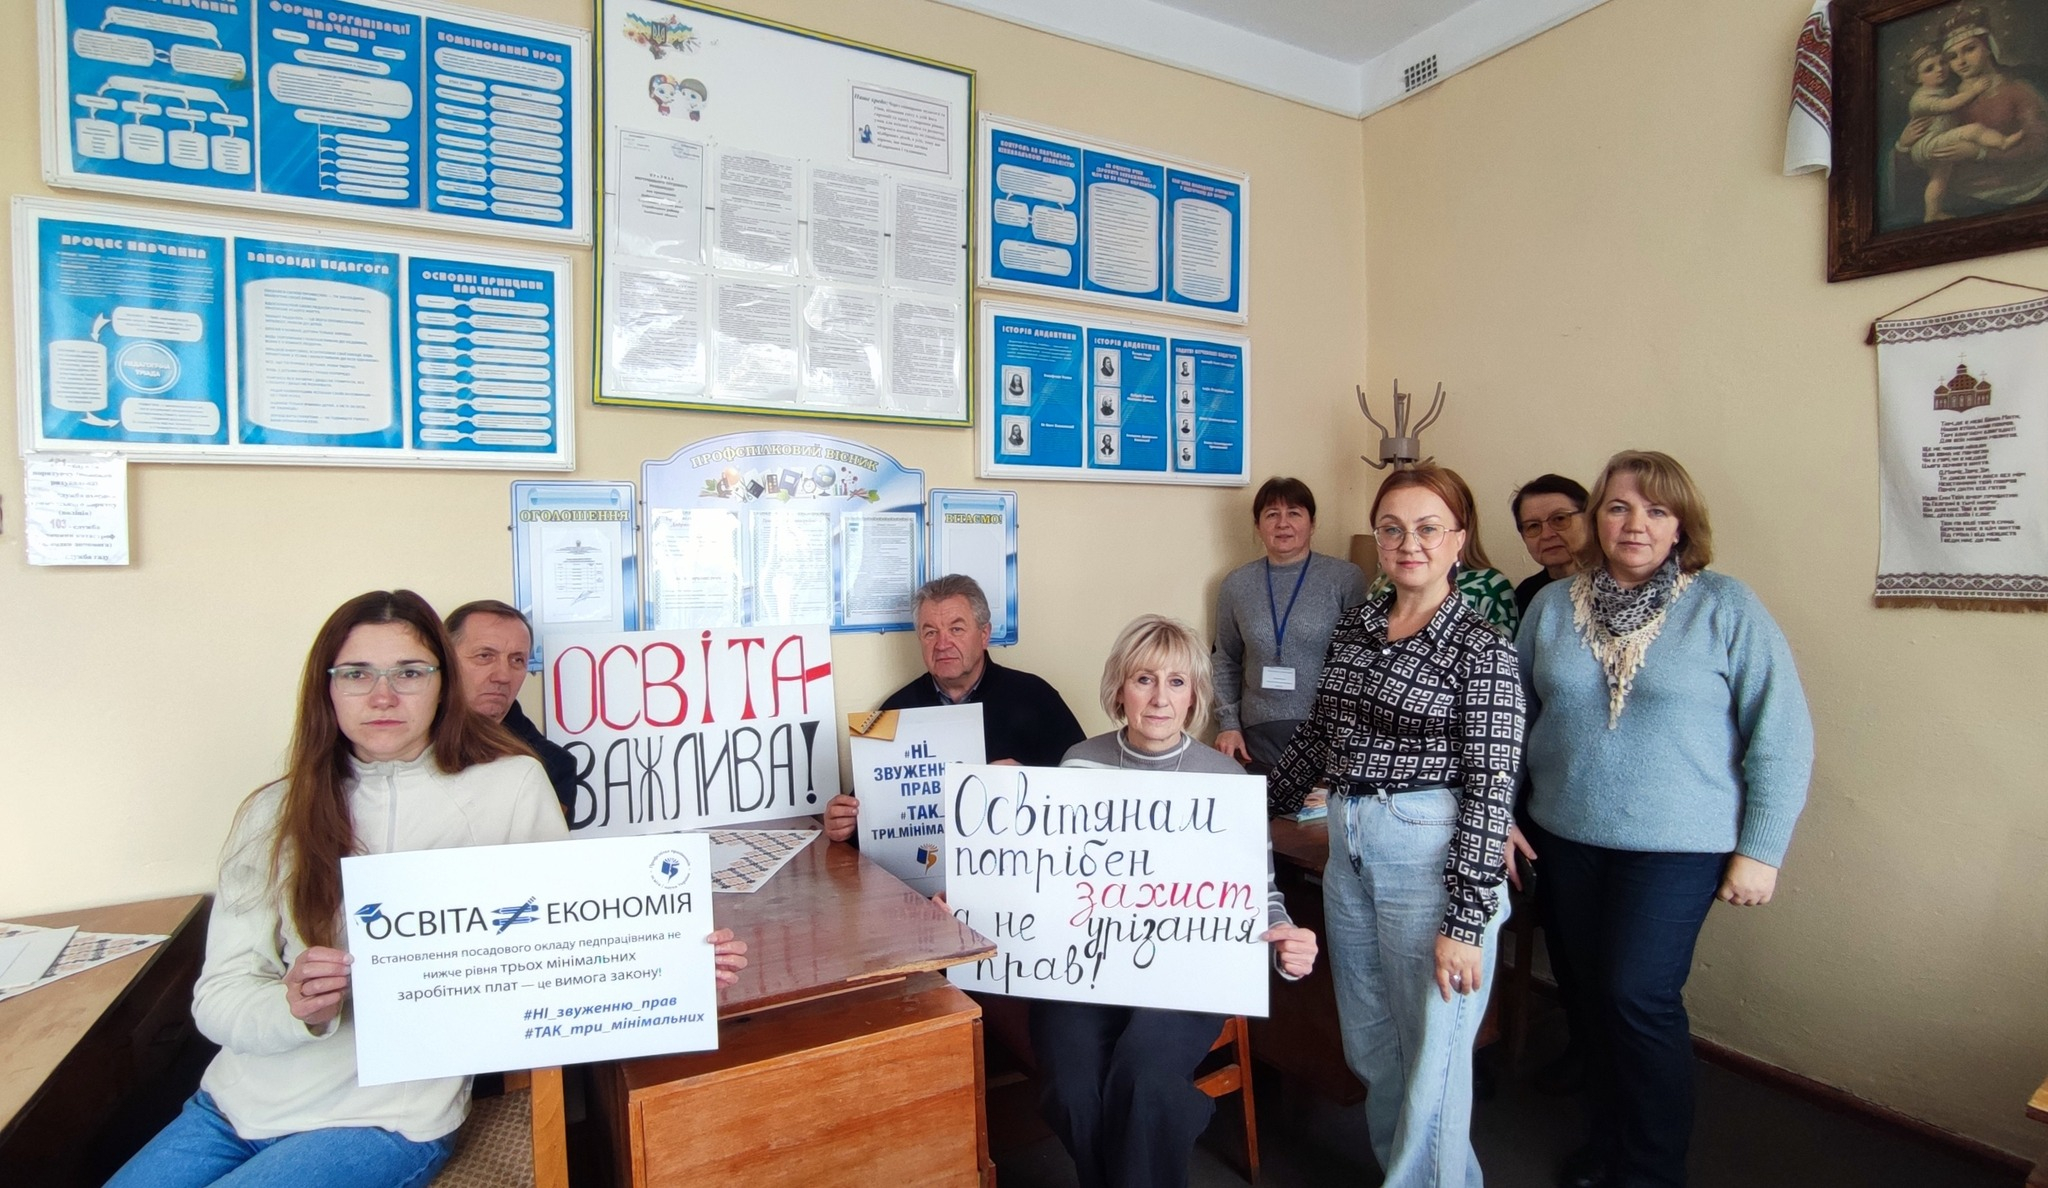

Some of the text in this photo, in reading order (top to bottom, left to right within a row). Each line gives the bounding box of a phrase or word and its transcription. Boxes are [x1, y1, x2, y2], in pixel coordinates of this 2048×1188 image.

[268, 0, 410, 35] ФОРМИ ОРГАНІЗАЦІЇ
[307, 20, 376, 40] НАВЧАННЯ
[438, 31, 562, 64] КОМБІНОВАНИЙ УРОК
[61, 234, 206, 259] ПРОЦЕС НАВЧАННЯ
[247, 252, 390, 276] ЗАПОВІДІ ПЕДАГОГА
[422, 270, 477, 284] ОСНОВНІ
[453, 284, 516, 298] НАВЧАННЯ
[1002, 326, 1076, 340] ІСТОРІЯ ДИДАКТИКИ
[1094, 338, 1121, 346] ІСТОРІЯ
[690, 444, 880, 472] ПРОФСПІЛКОВИЙ ВІСНИК
[50, 519, 66, 529] 103
[520, 510, 630, 522] ОГОЛОШЕННЯ
[945, 513, 1002, 524] ВІТАЄМО!
[567, 720, 820, 831] ВАЖЛИВА!
[874, 763, 955, 782] ЗВУЖЕНН
[901, 780, 942, 796] ПРАВ
[954, 772, 1228, 838] Освітянам
[955, 840, 1155, 893] потрібен
[364, 892, 692, 940] ОСВІТА ЕКОНОМІЯ
[371, 930, 682, 966] Встановлення посадового окладу педпрацівника не
[995, 912, 1036, 942] не
[1084, 913, 1259, 969] урізання
[423, 952, 637, 980] нижче рівня трьох мінімальних
[976, 944, 1102, 994] прав!
[397, 982, 481, 1002] заробітних
[484, 980, 518, 993] плат
[537, 978, 552, 990] це
[554, 972, 608, 988] вимога
[610, 968, 662, 982] закону!
[524, 996, 678, 1021] #НІ_звуженню_прав
[524, 1012, 705, 1040] #ТАК_три_мінімальних
